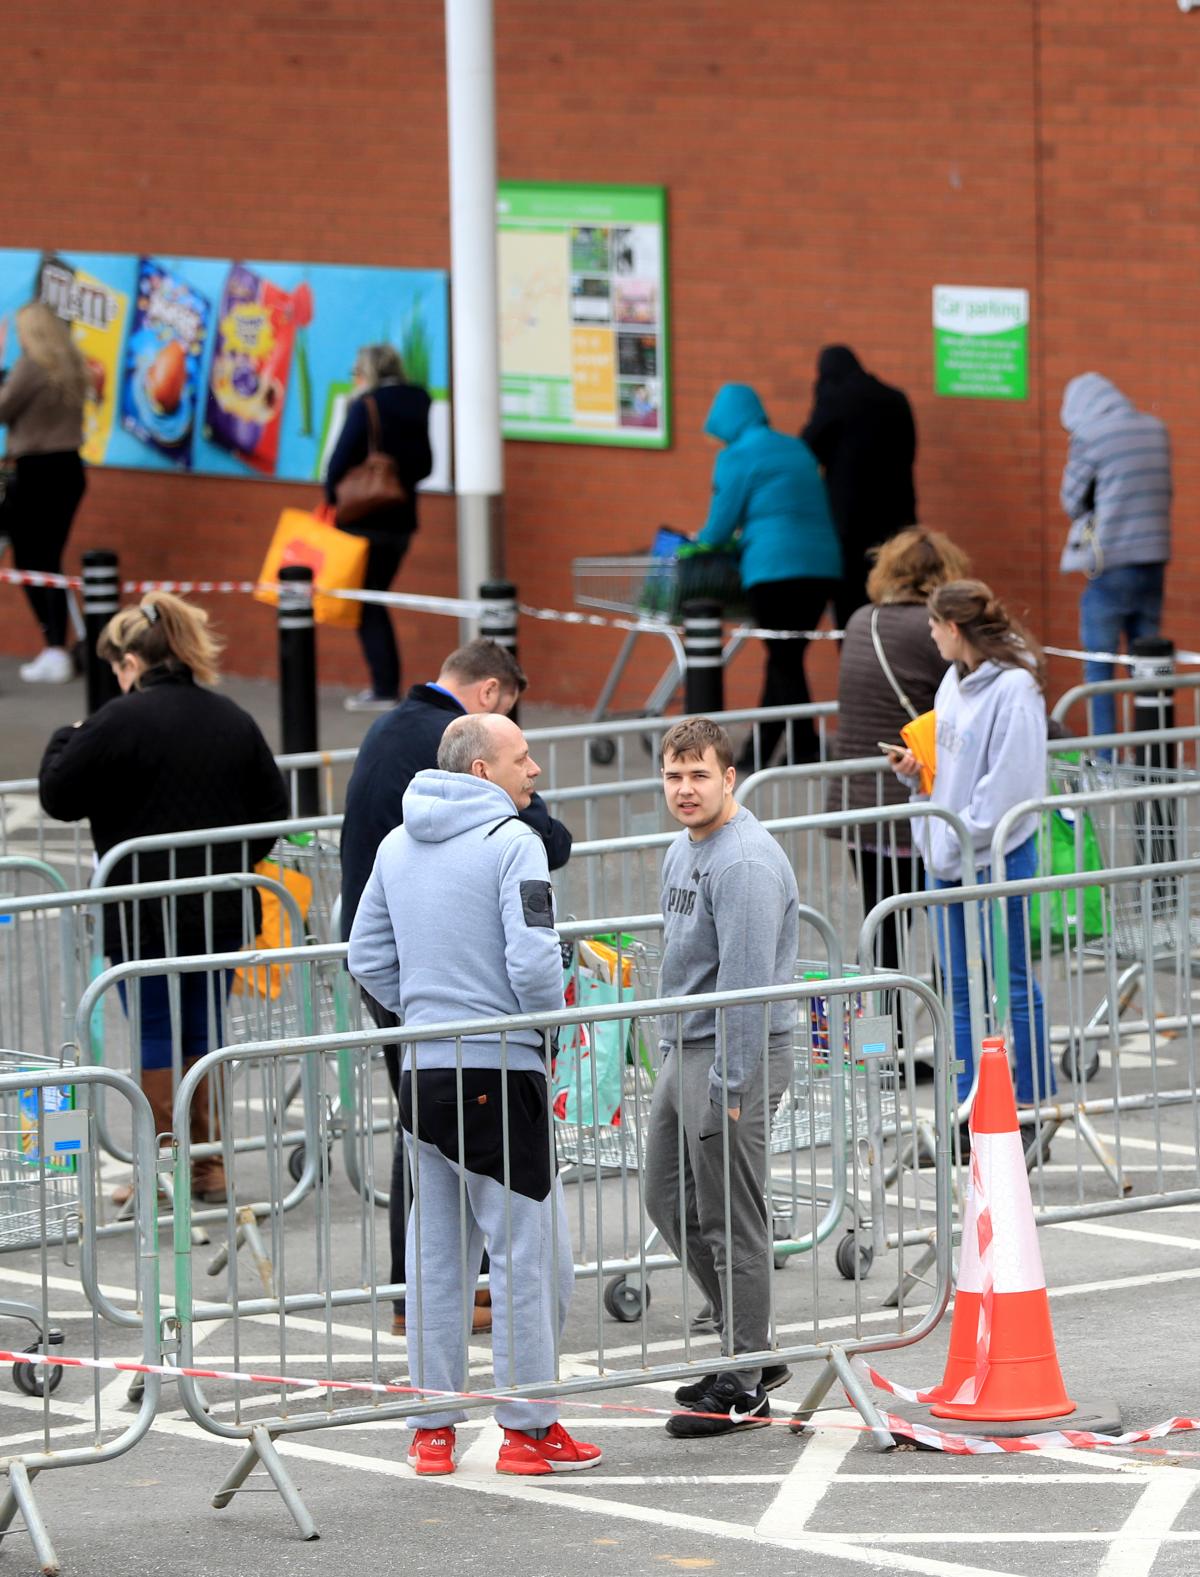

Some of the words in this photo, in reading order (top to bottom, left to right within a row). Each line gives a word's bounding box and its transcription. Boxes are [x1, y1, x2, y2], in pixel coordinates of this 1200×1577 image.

[937, 293, 960, 316] Car
[966, 298, 1021, 320] parking
[430, 1438, 446, 1446] AIR
